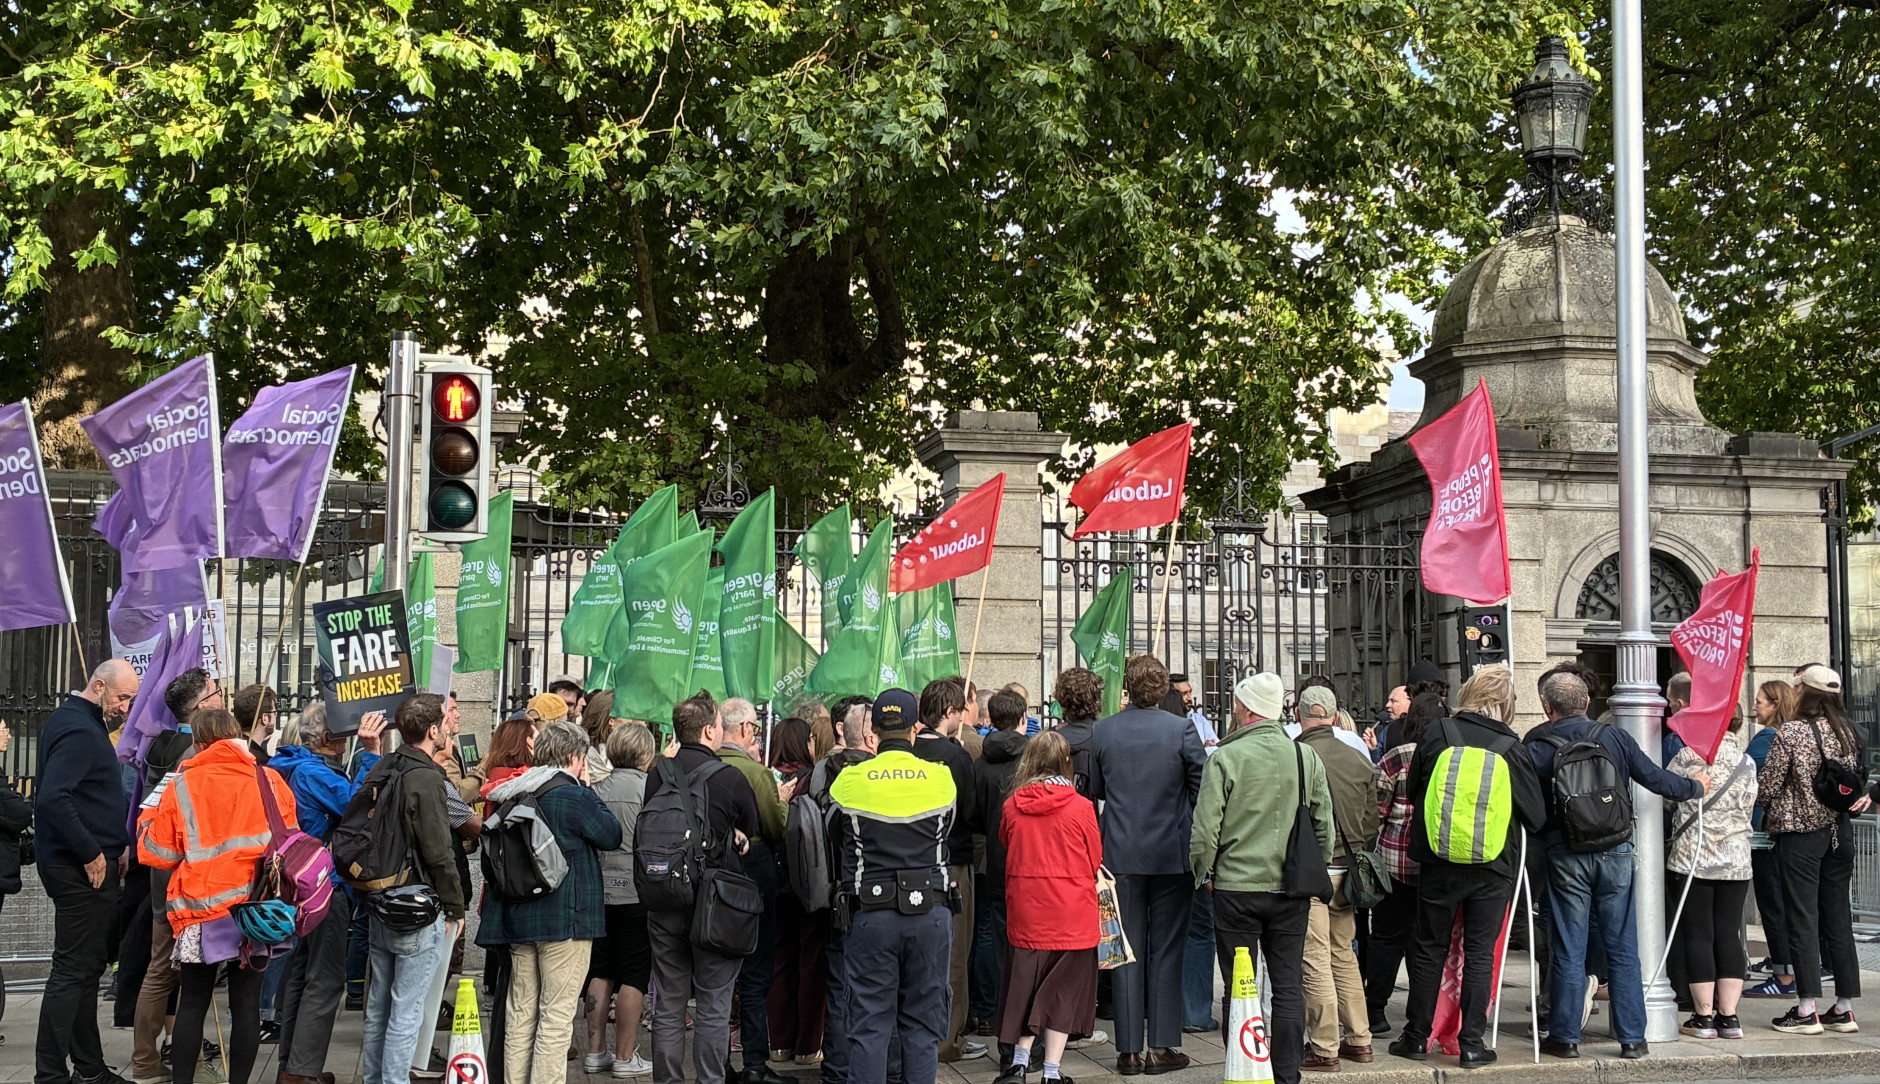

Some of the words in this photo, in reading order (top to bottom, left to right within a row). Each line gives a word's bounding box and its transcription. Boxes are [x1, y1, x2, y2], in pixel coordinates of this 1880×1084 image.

[327, 608, 363, 635] STOP
[365, 604, 394, 628] THE
[330, 629, 401, 678] FARE
[336, 673, 404, 703] INCREASE
[867, 769, 928, 781] GARDA
